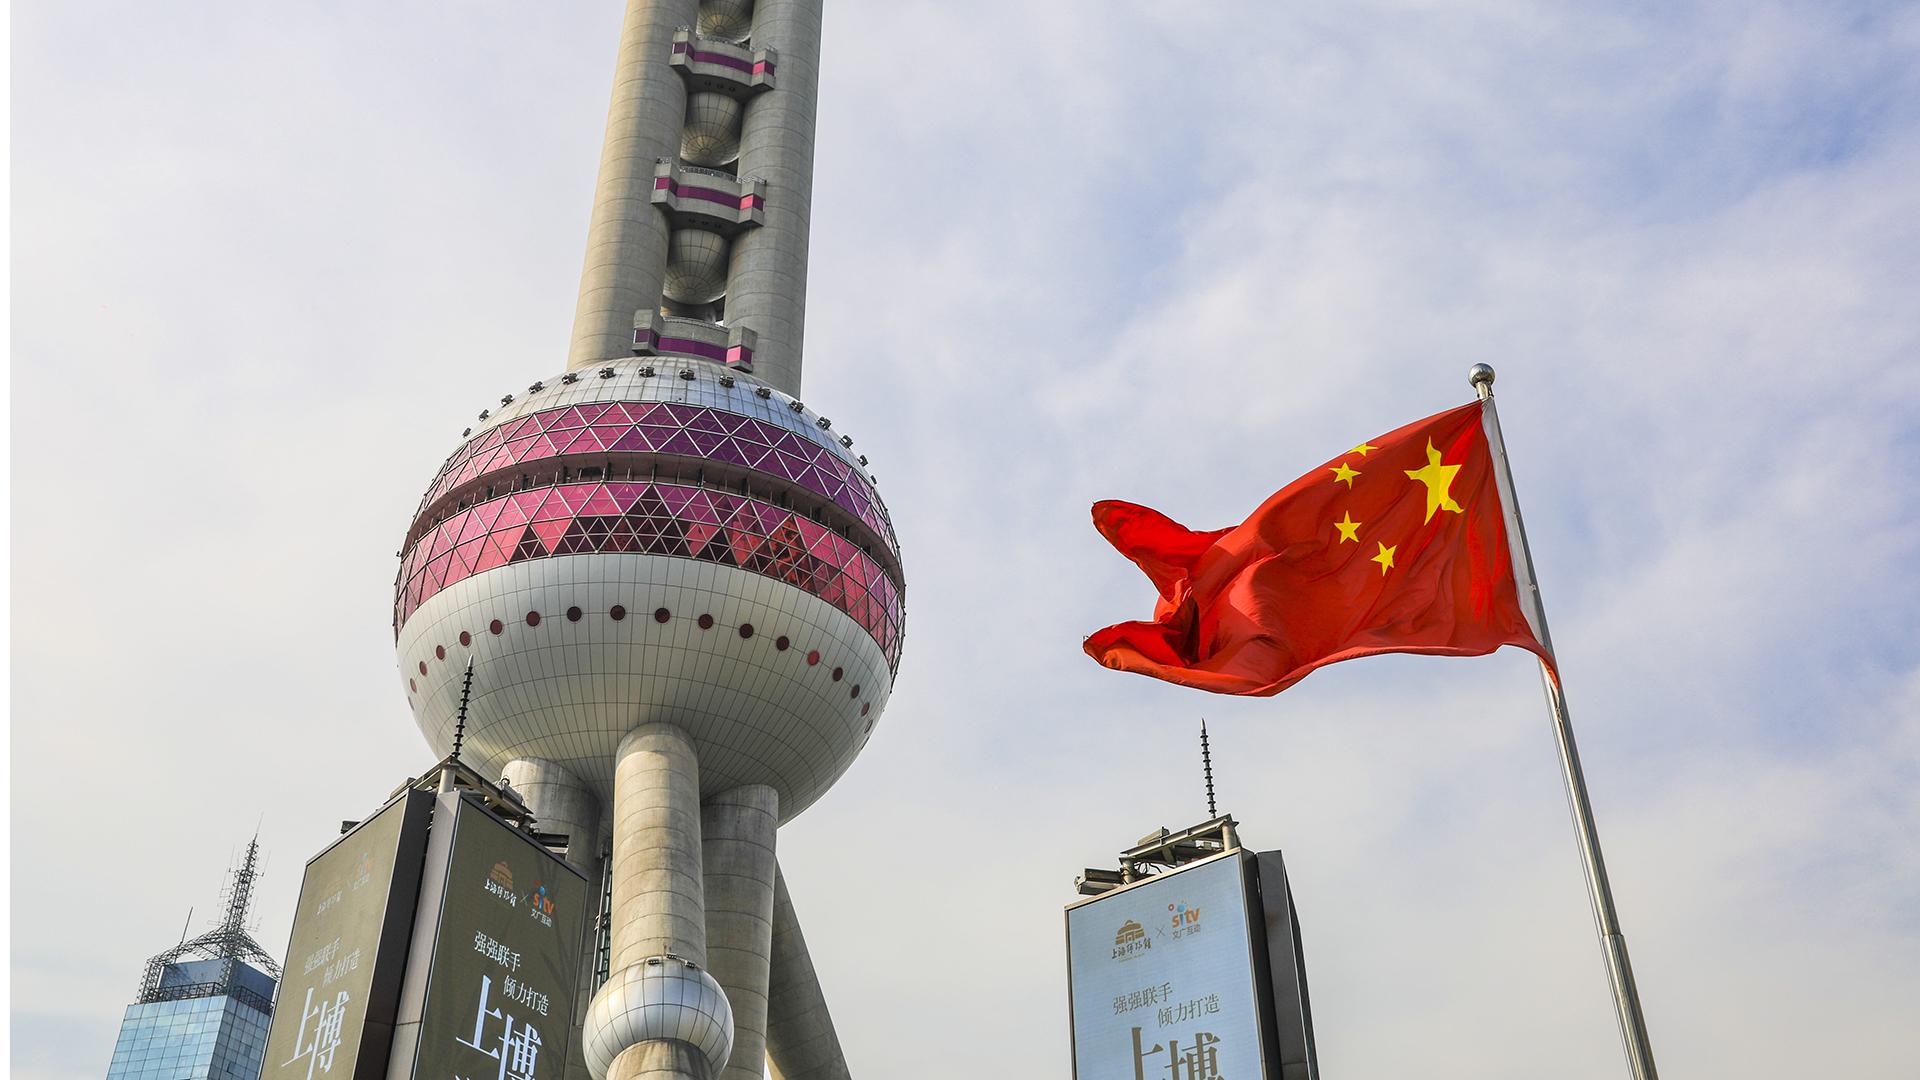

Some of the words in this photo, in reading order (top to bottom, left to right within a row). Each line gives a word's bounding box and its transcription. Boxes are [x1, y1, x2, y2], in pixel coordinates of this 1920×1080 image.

[533, 885, 555, 914] sitv
[1171, 904, 1201, 929] sitv
[474, 930, 522, 973] 强强联手
[502, 975, 549, 1017] 倾力打造
[1112, 982, 1174, 1016] 强强联手
[1157, 994, 1221, 1029] 倾力打造
[281, 987, 350, 1080] 上博
[455, 973, 542, 1080] 上博
